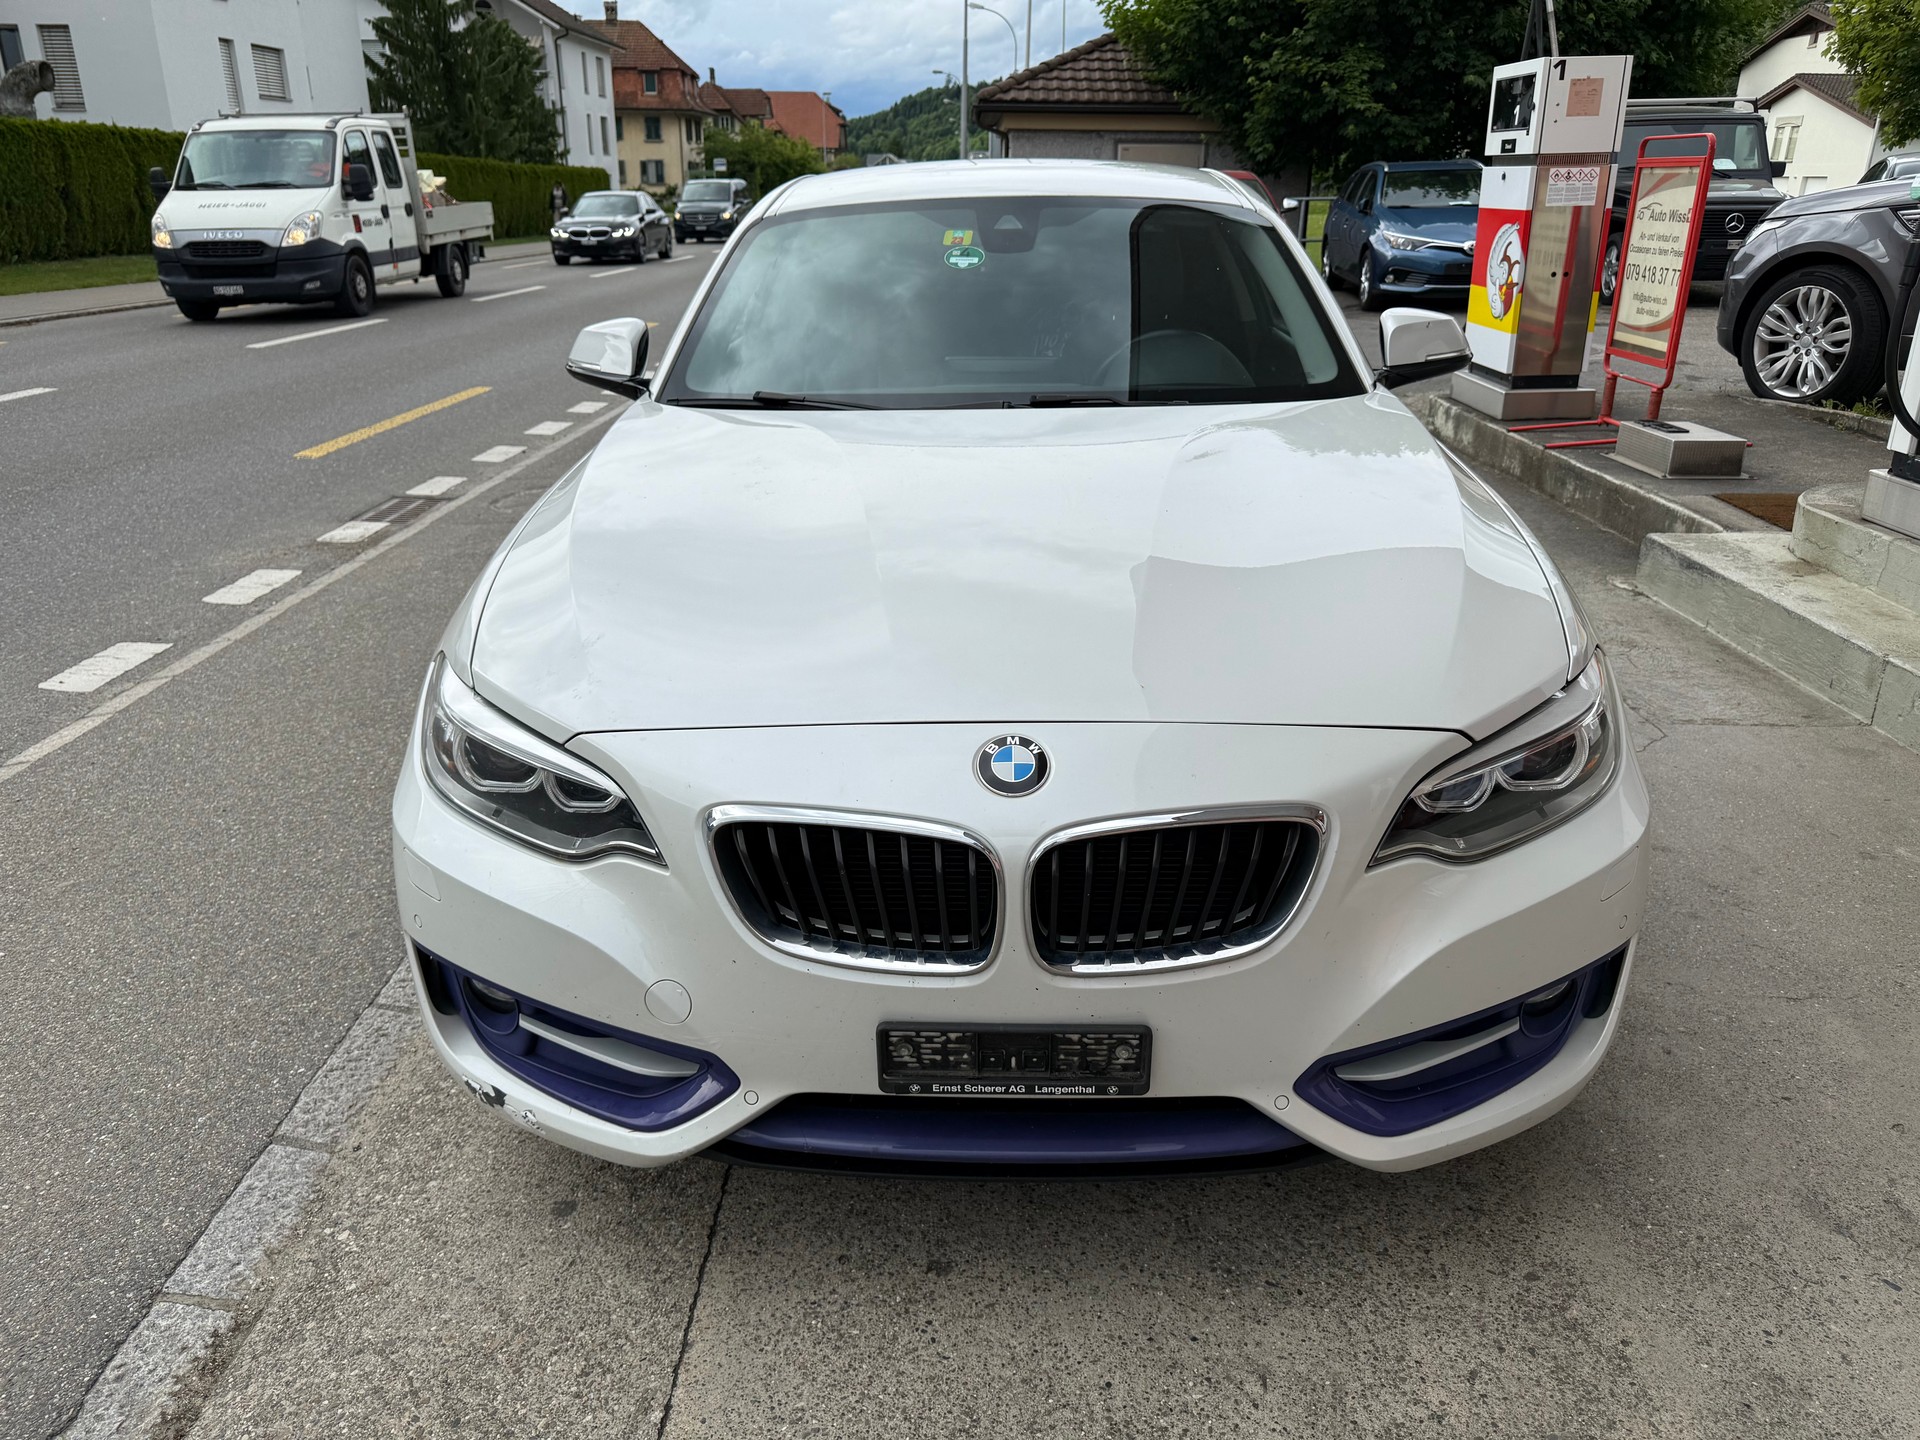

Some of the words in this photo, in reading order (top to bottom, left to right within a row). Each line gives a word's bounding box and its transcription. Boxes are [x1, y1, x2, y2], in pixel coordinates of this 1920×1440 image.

[1553, 60, 1567, 80] 1
[1513, 105, 1520, 126] 1
[1648, 209, 1667, 222] Auto
[203, 231, 243, 239] IVECO
[1647, 233, 1656, 241] und
[1656, 233, 1672, 242] Verkauf
[1626, 263, 1641, 281] 079
[1641, 265, 1657, 284] 418
[1657, 267, 1669, 286] 37
[1632, 292, 1667, 305] info@auto-wiss.ch
[985, 736, 1042, 755] BMW
[932, 1084, 961, 1093] Ernst
[964, 1084, 1006, 1094] Scherer
[1008, 1085, 1026, 1094] AG
[1034, 1085, 1096, 1095] Langenthal
